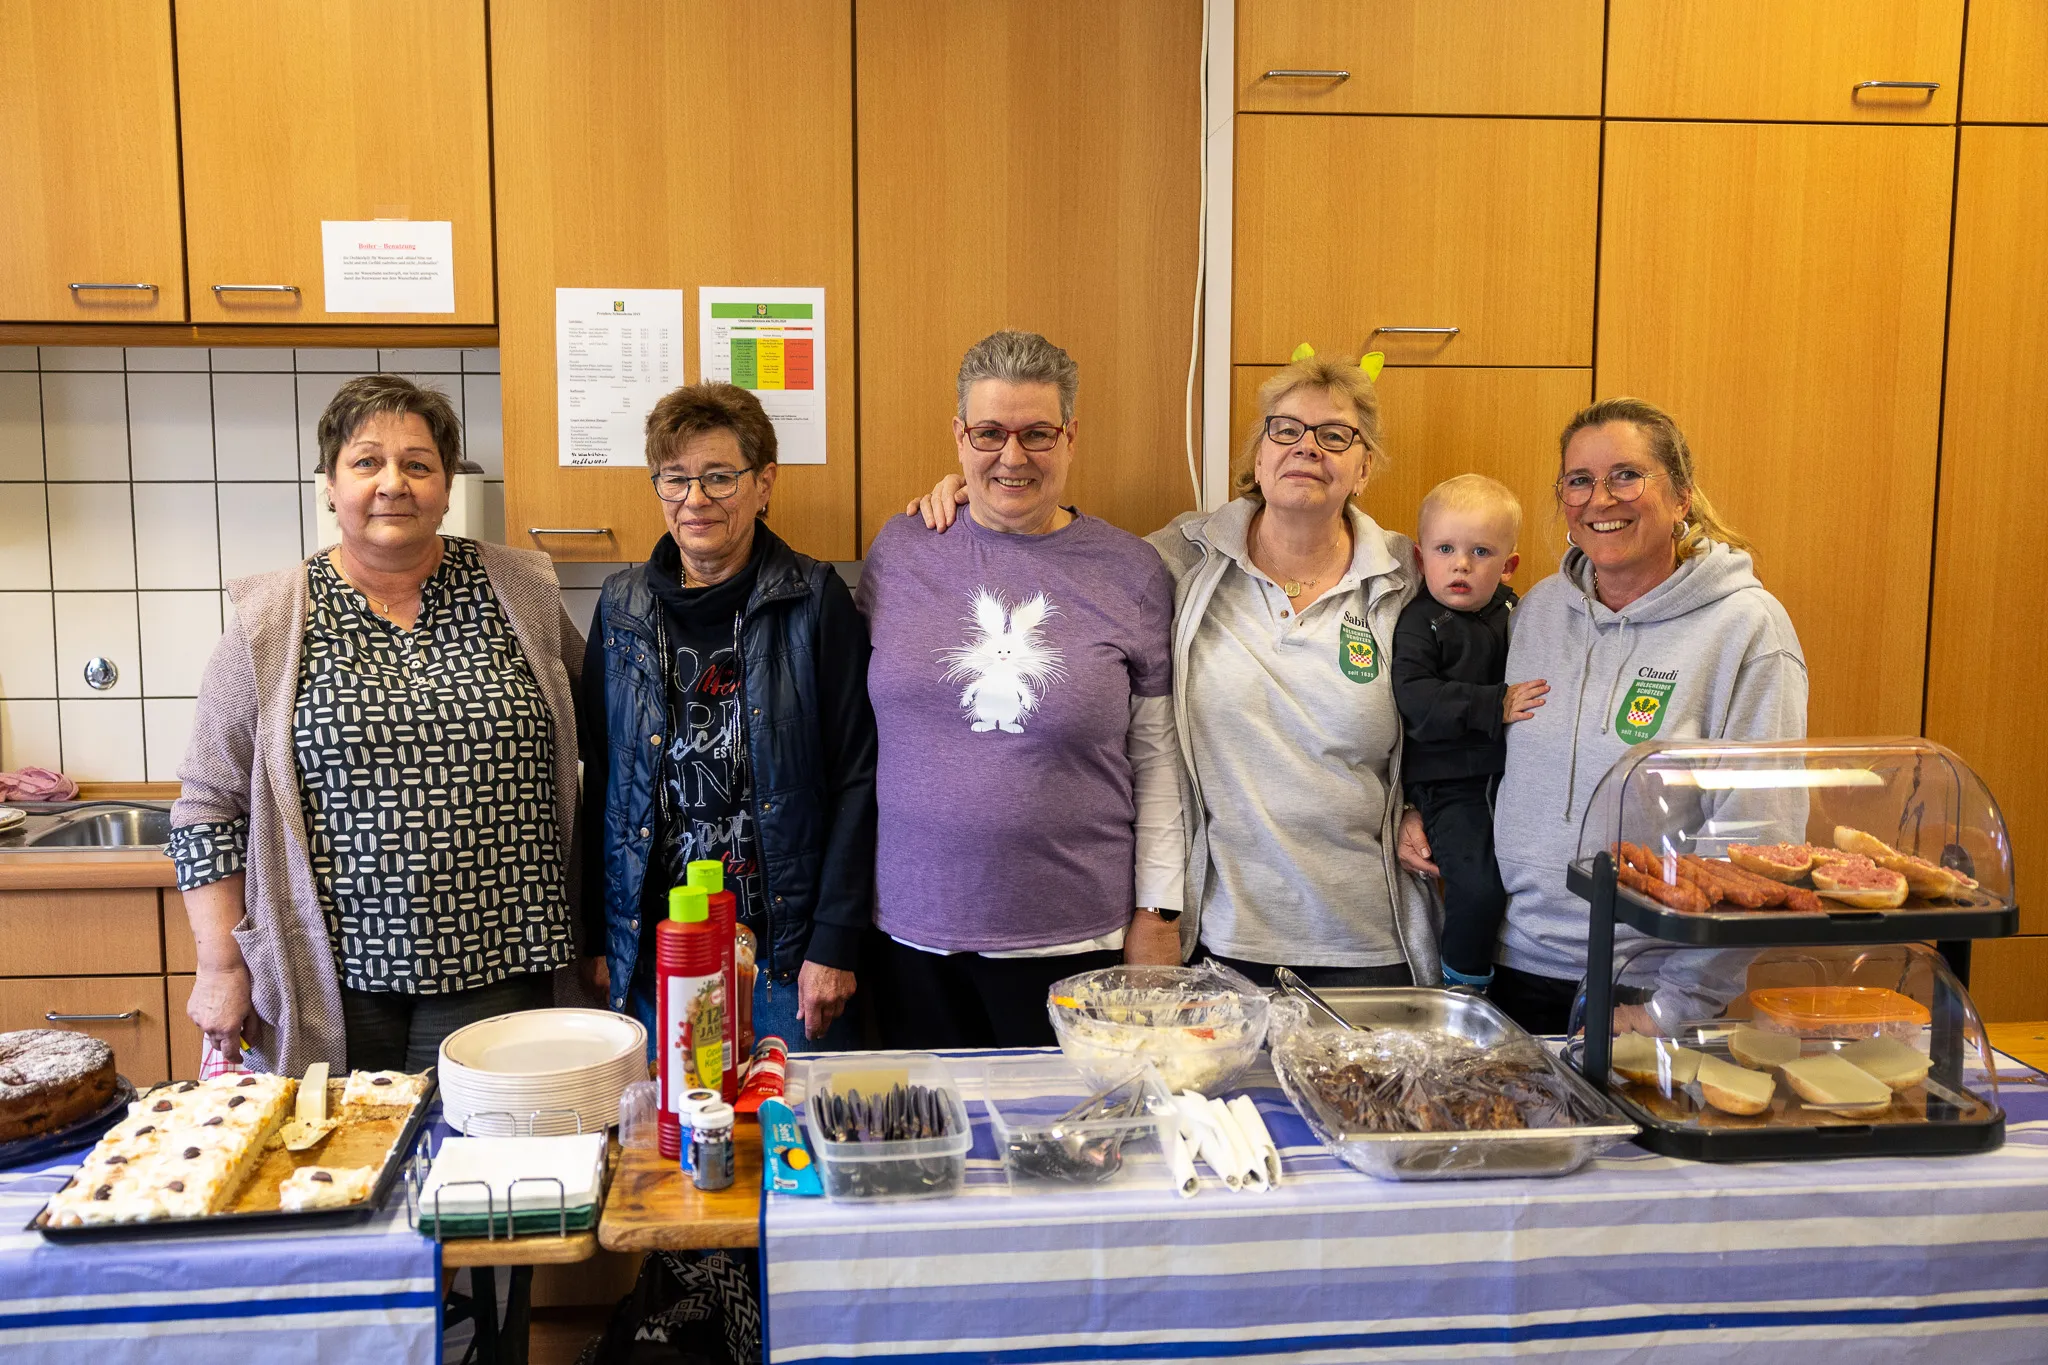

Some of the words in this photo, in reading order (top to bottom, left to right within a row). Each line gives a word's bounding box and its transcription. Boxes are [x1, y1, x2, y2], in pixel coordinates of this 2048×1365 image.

[1638, 666, 1679, 681] Claudi
[1635, 681, 1672, 691] HÜLSCHEIDER
[1636, 688, 1665, 697] SCHÜTZEN
[1634, 730, 1649, 739] 1635
[779, 1123, 795, 1143] Senf
